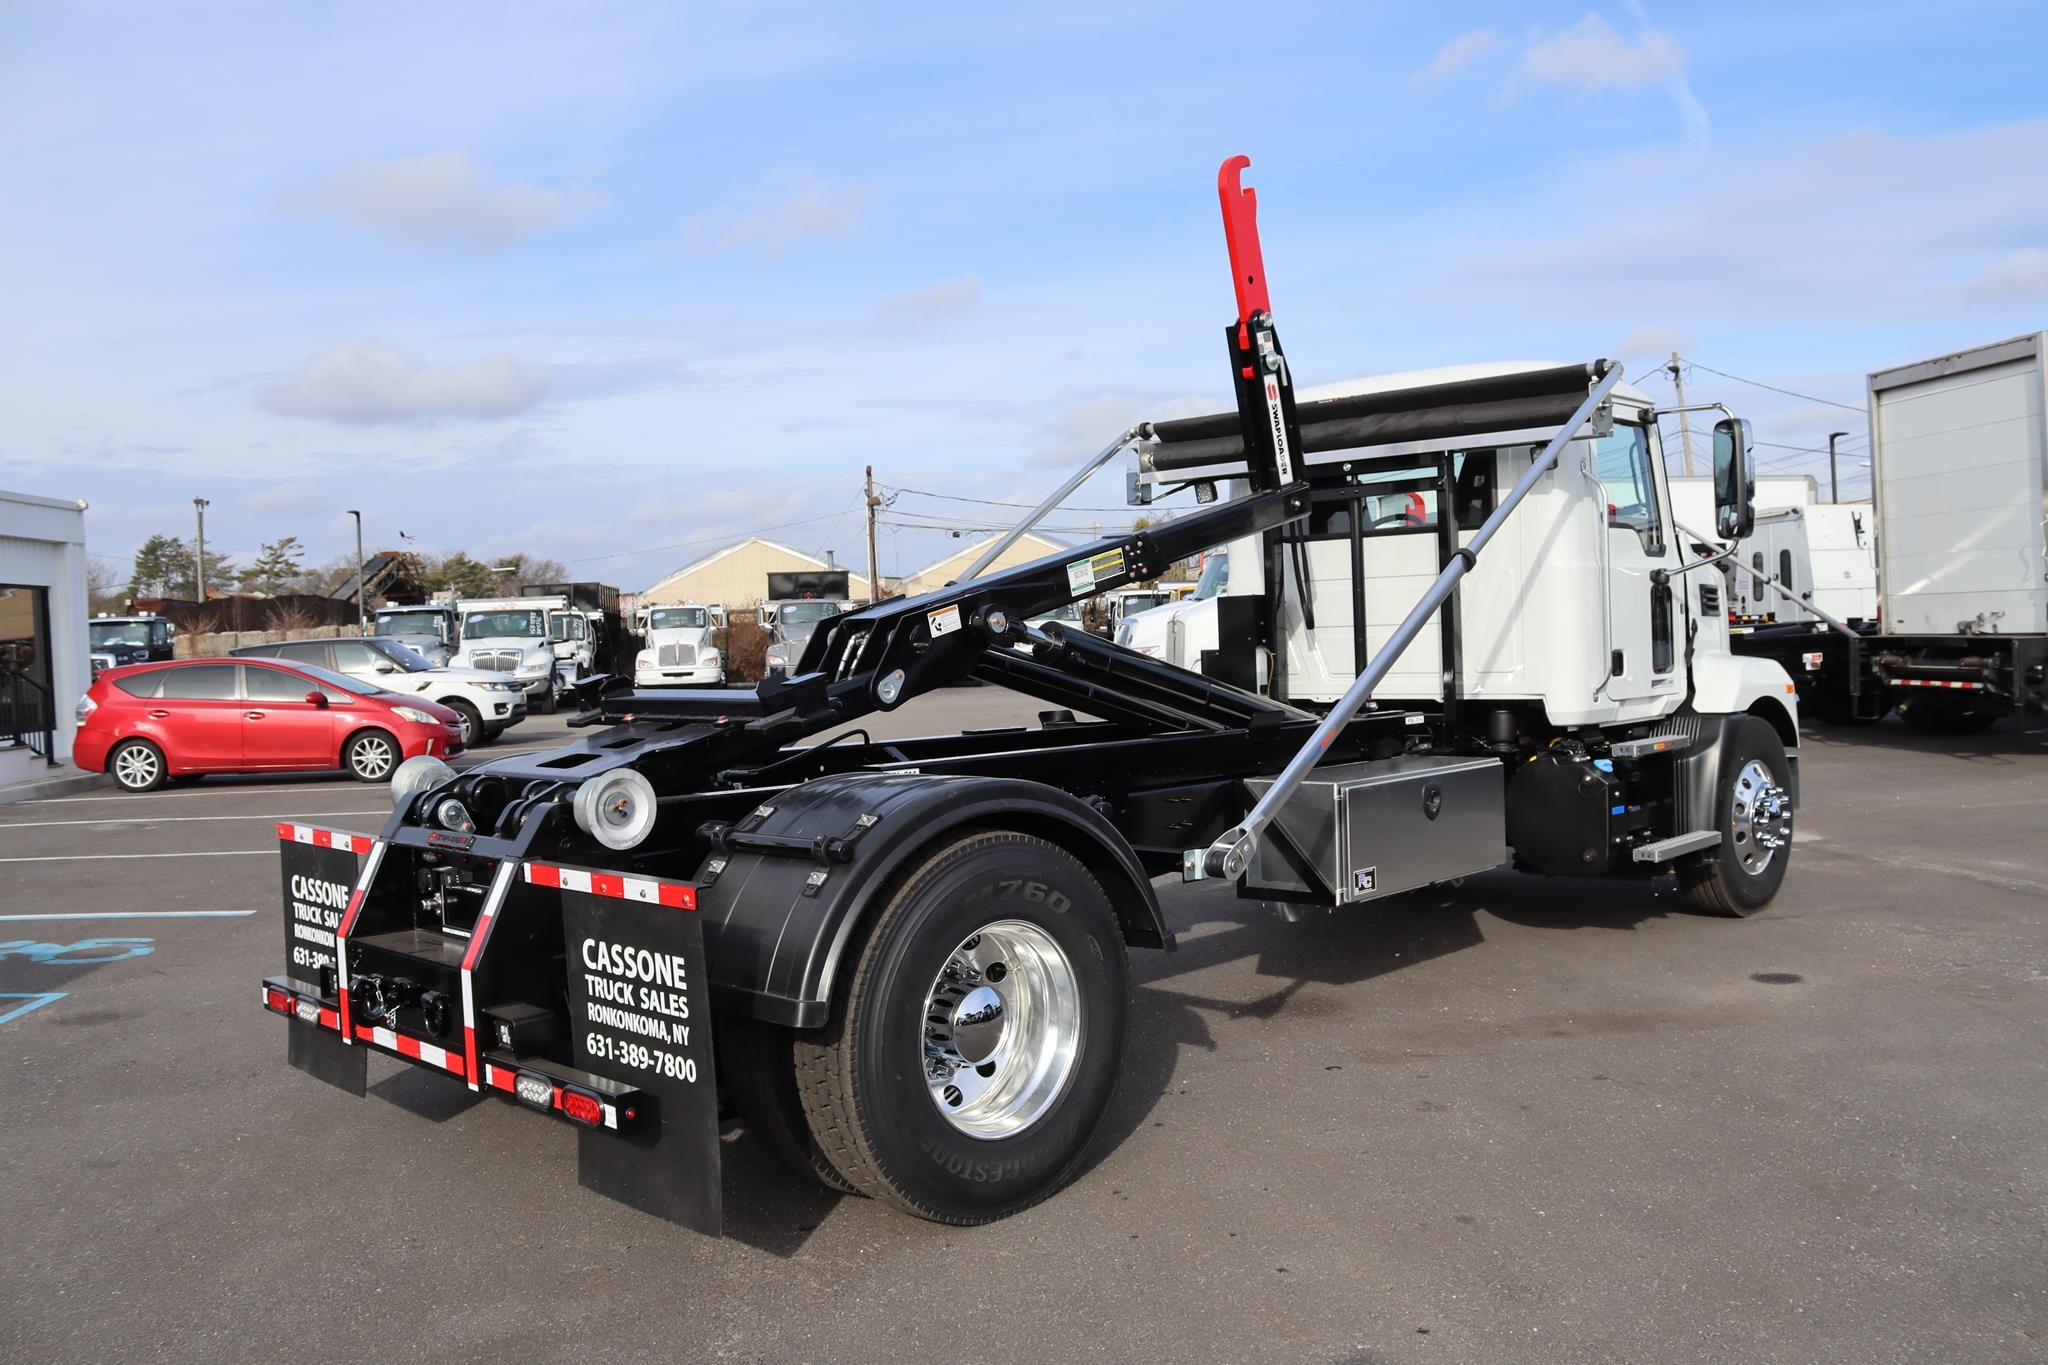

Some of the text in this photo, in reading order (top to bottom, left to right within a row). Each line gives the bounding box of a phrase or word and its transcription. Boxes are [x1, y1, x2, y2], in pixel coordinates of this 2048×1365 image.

[1271, 403, 1289, 475] SWAPLOADER
[293, 902, 342, 929] TRUCK SAL
[294, 923, 335, 948] RONKONKOM
[582, 938, 687, 990] CASSONE
[585, 974, 689, 1019] TRUCK SALES
[587, 1002, 690, 1046] RONKONKOMA, NY
[586, 1032, 697, 1083] 631-389-7800
